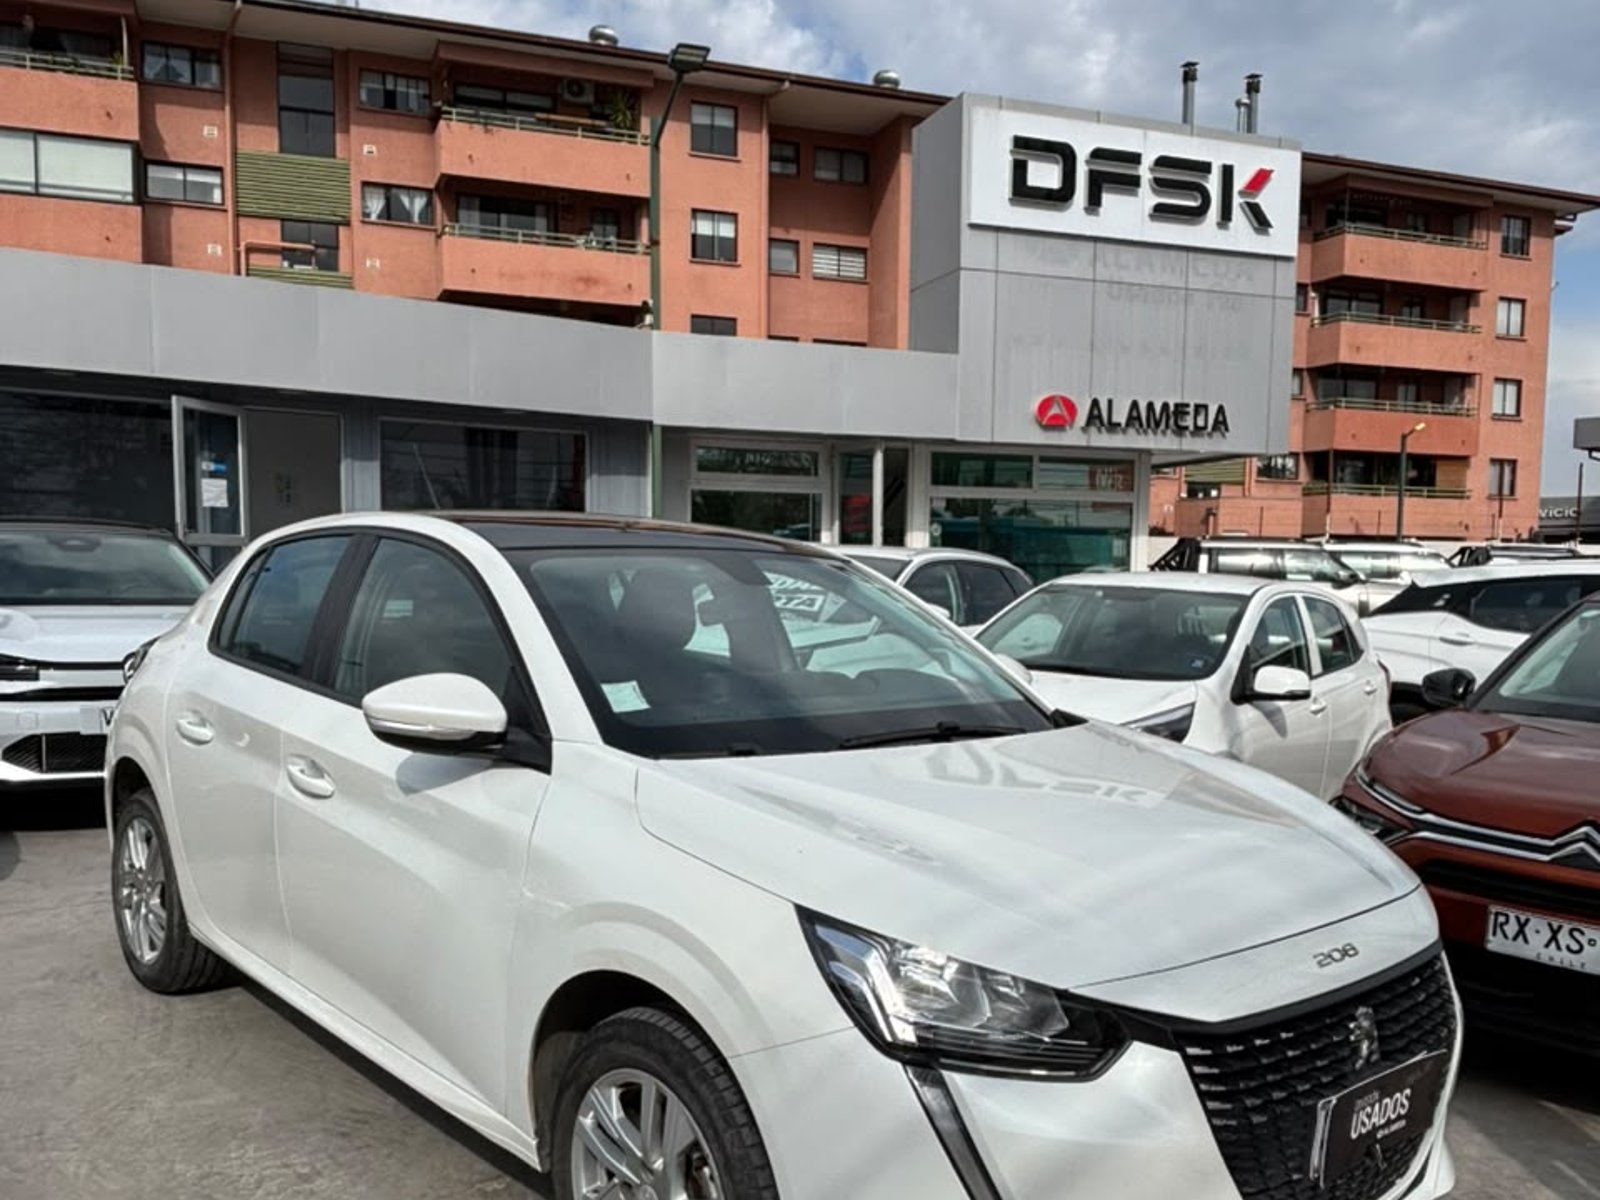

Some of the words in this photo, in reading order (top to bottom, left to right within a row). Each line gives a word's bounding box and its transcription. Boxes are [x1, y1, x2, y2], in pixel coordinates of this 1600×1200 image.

[1010, 135, 1275, 234] DFSK
[1083, 397, 1230, 436] ALAMEDA
[1312, 942, 1361, 969] 208
[1350, 1088, 1412, 1140] USADOS
